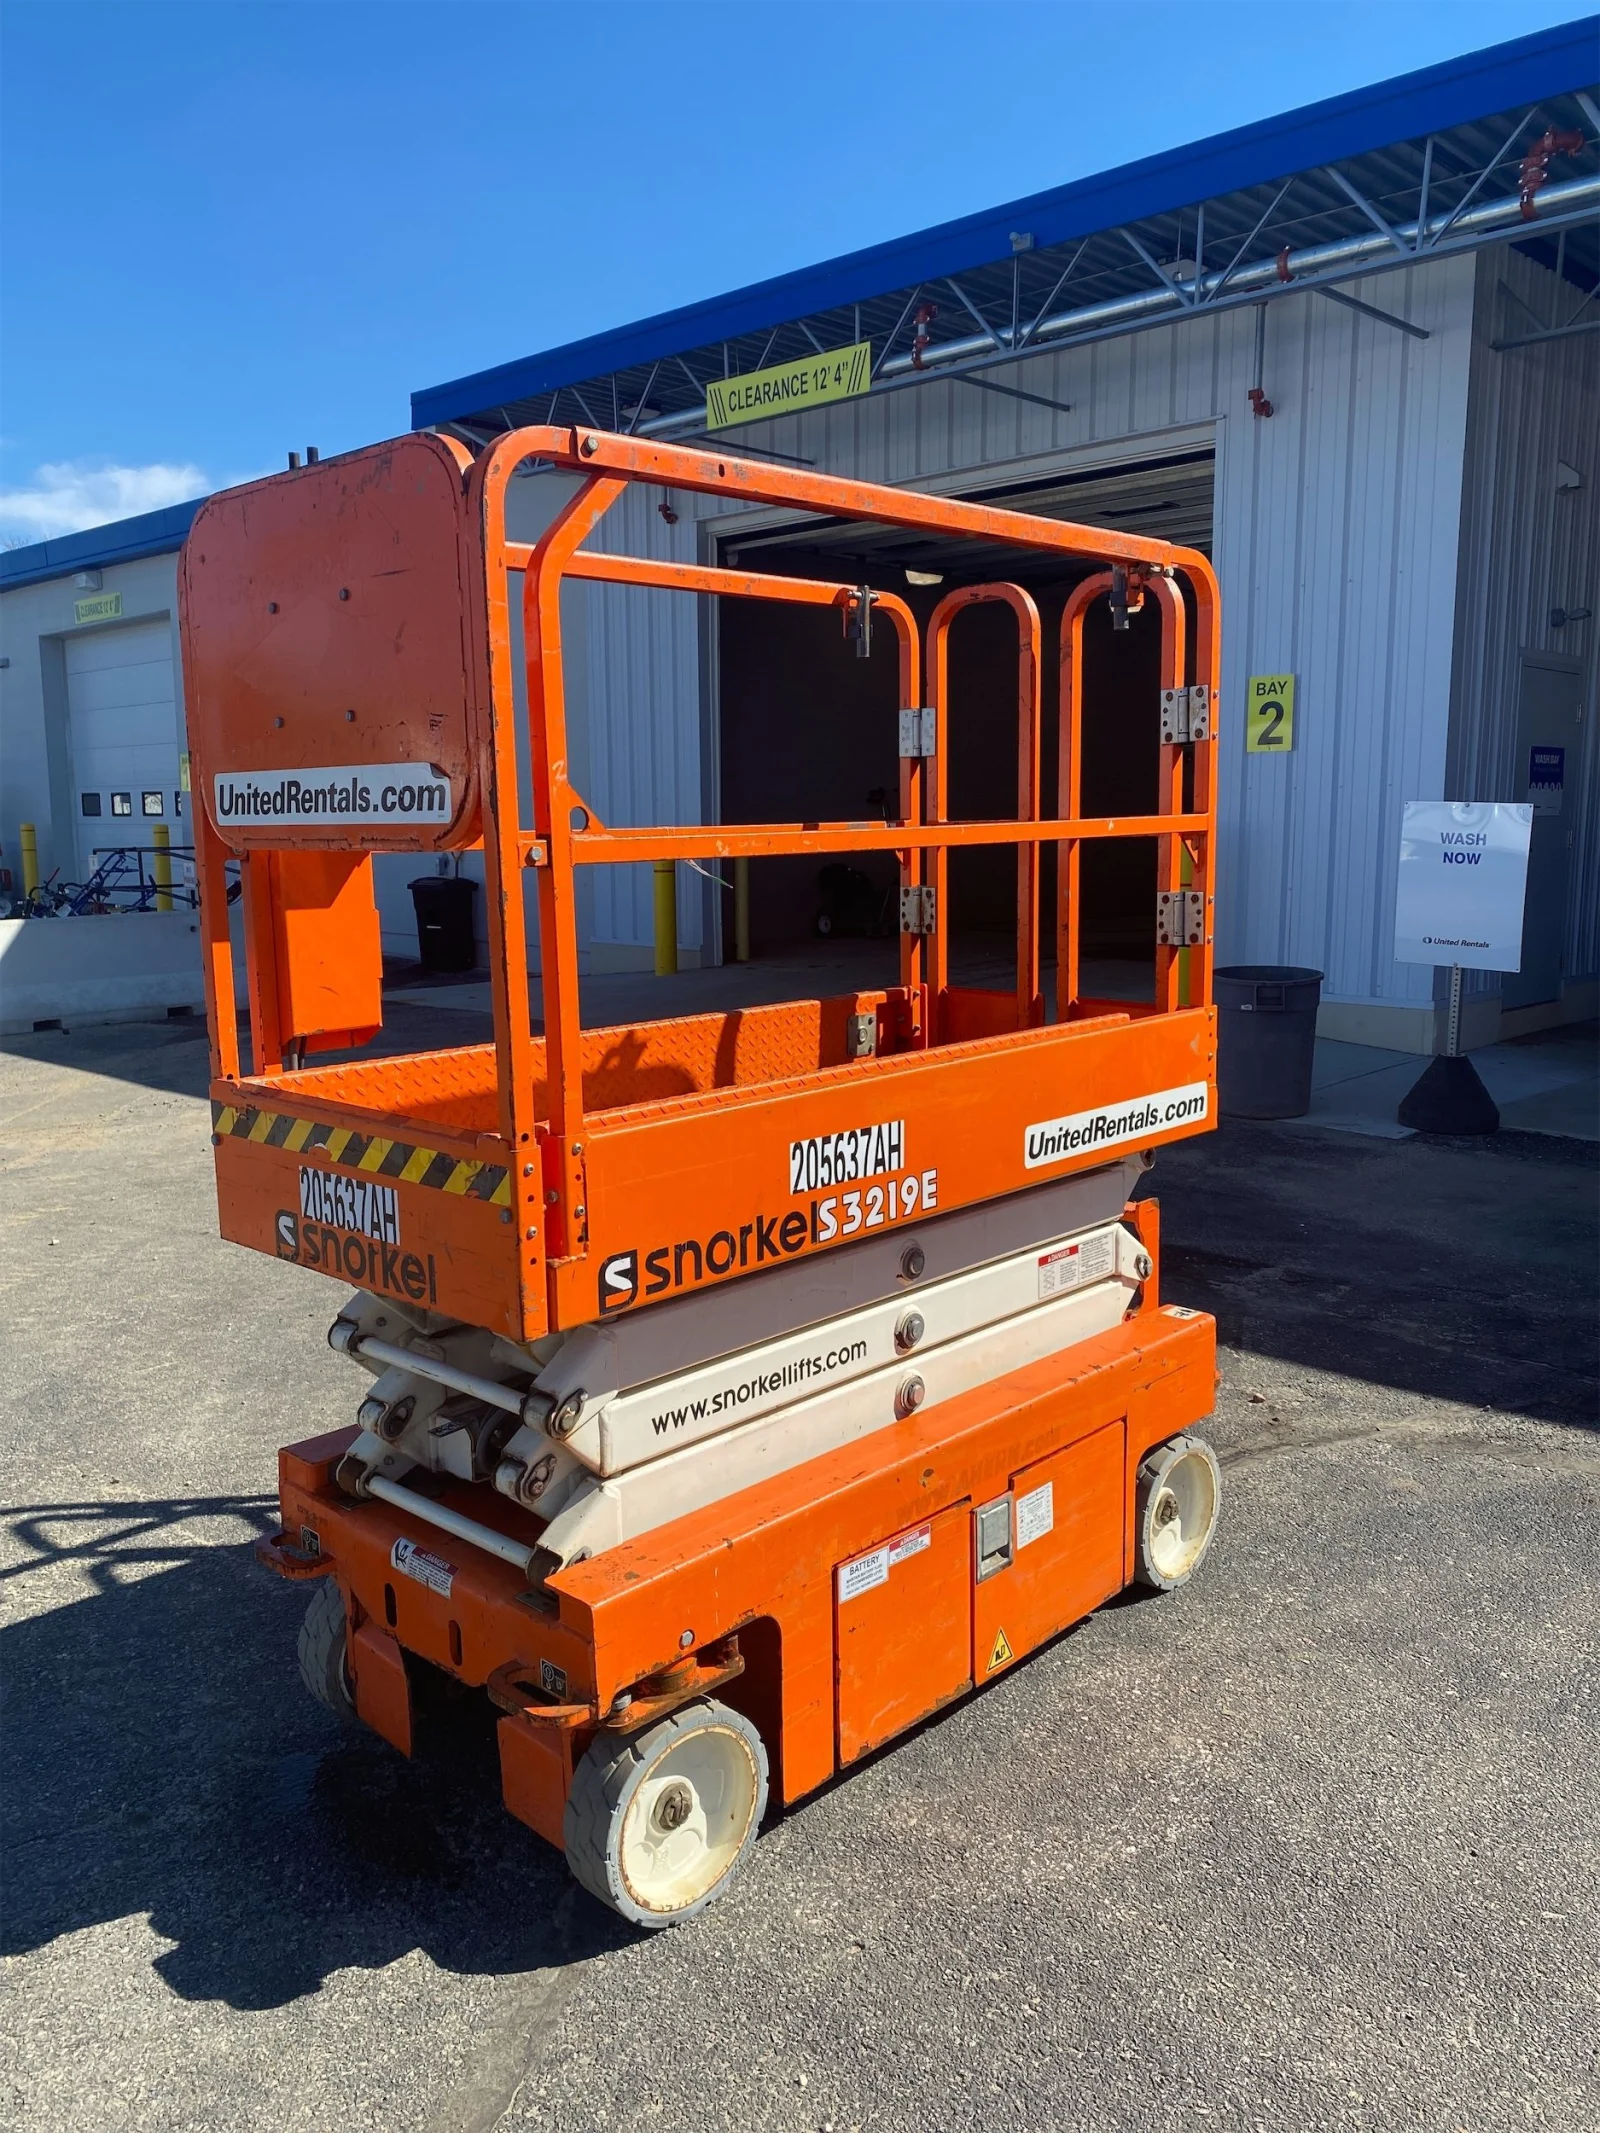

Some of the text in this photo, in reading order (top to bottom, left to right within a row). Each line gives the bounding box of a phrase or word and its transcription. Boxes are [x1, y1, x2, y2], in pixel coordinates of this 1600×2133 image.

[728, 371, 808, 412] CLEARANCE
[1256, 680, 1288, 696] BAY
[1257, 700, 1284, 746] 2
[219, 776, 446, 817] UnitedRentals.com
[1440, 832, 1487, 846] WASH
[1442, 851, 1482, 865] NOW
[1433, 938, 1490, 948] United Rentals
[1028, 1090, 1206, 1161] UnitedRentals.com
[791, 1121, 902, 1194] 205637AH
[300, 1165, 398, 1245] 205637AH
[645, 1200, 817, 1296] snorkel
[817, 1167, 938, 1242] S3219E
[302, 1223, 437, 1305] snorkel
[1051, 1249, 1070, 1261] DANGER
[651, 1340, 867, 1436] www.snorkellifts.com
[426, 1553, 451, 1571] DANGER
[849, 1554, 880, 1576] BATTERY
